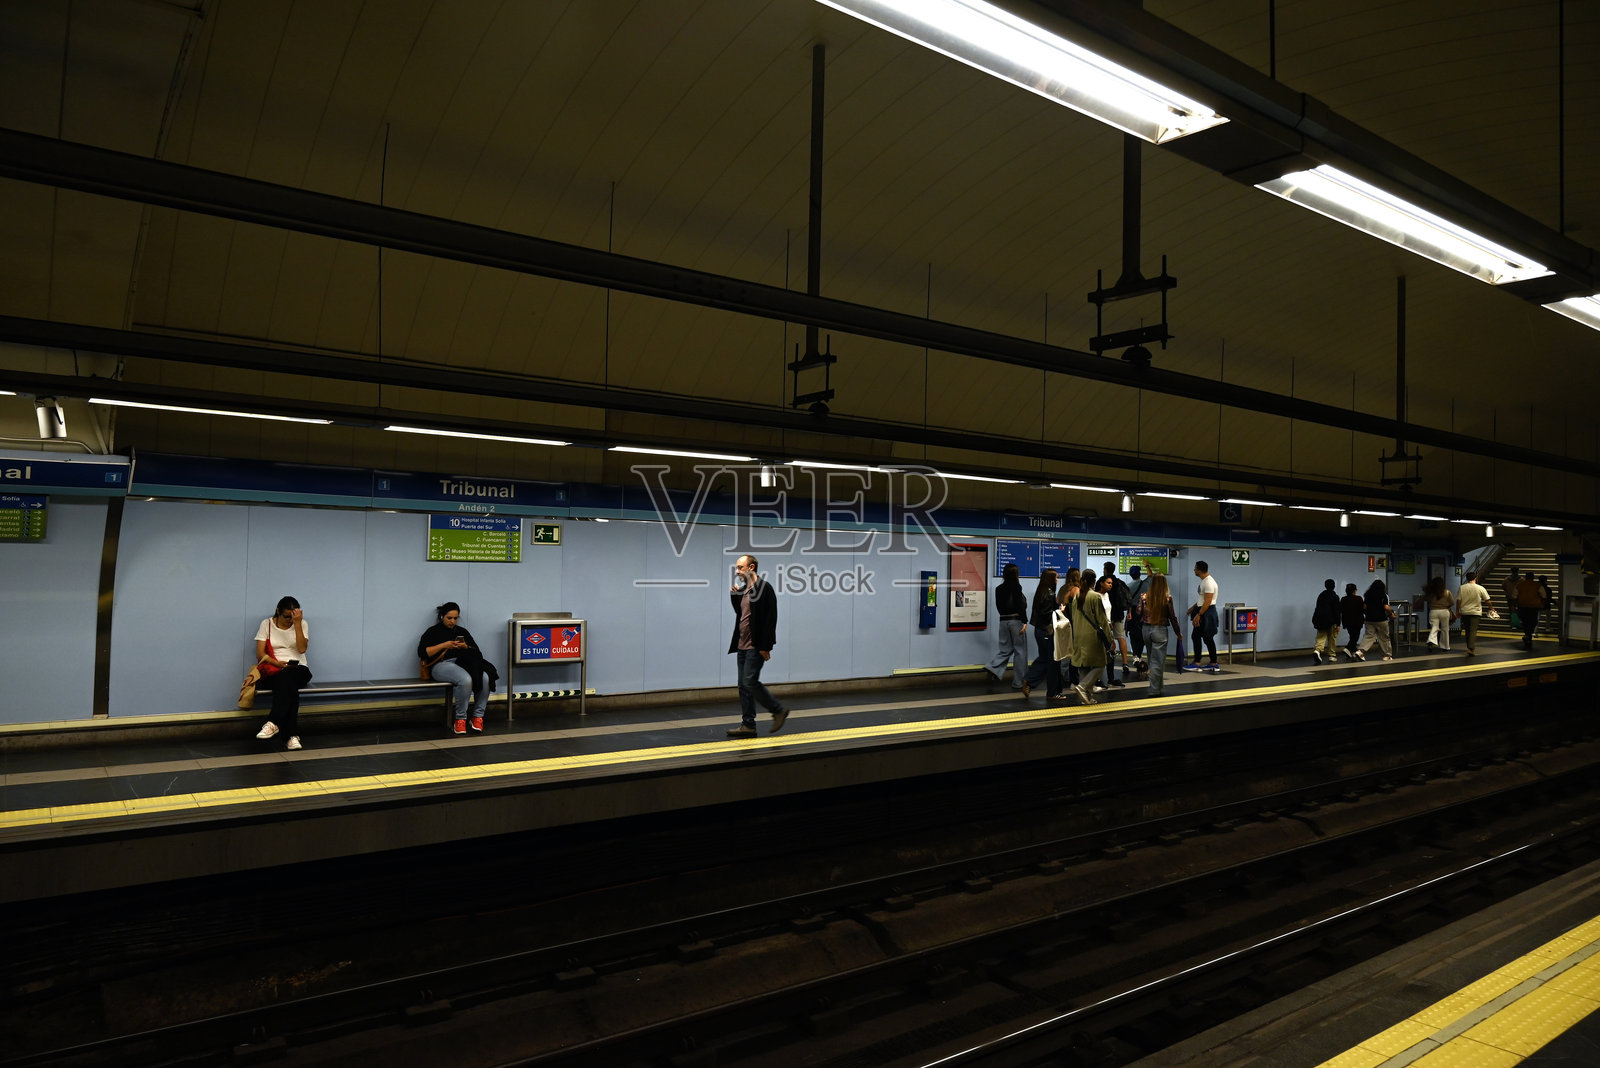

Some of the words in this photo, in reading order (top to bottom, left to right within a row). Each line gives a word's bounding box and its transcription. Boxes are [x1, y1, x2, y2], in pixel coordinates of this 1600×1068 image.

[439, 479, 515, 498] Tribunal
[458, 503, 487, 512] Andén
[490, 505, 496, 513] 2
[450, 518, 461, 527] 10
[1028, 516, 1063, 529] Tribunal
[532, 647, 549, 655] TUYO
[552, 646, 579, 654] CUÍDALO
